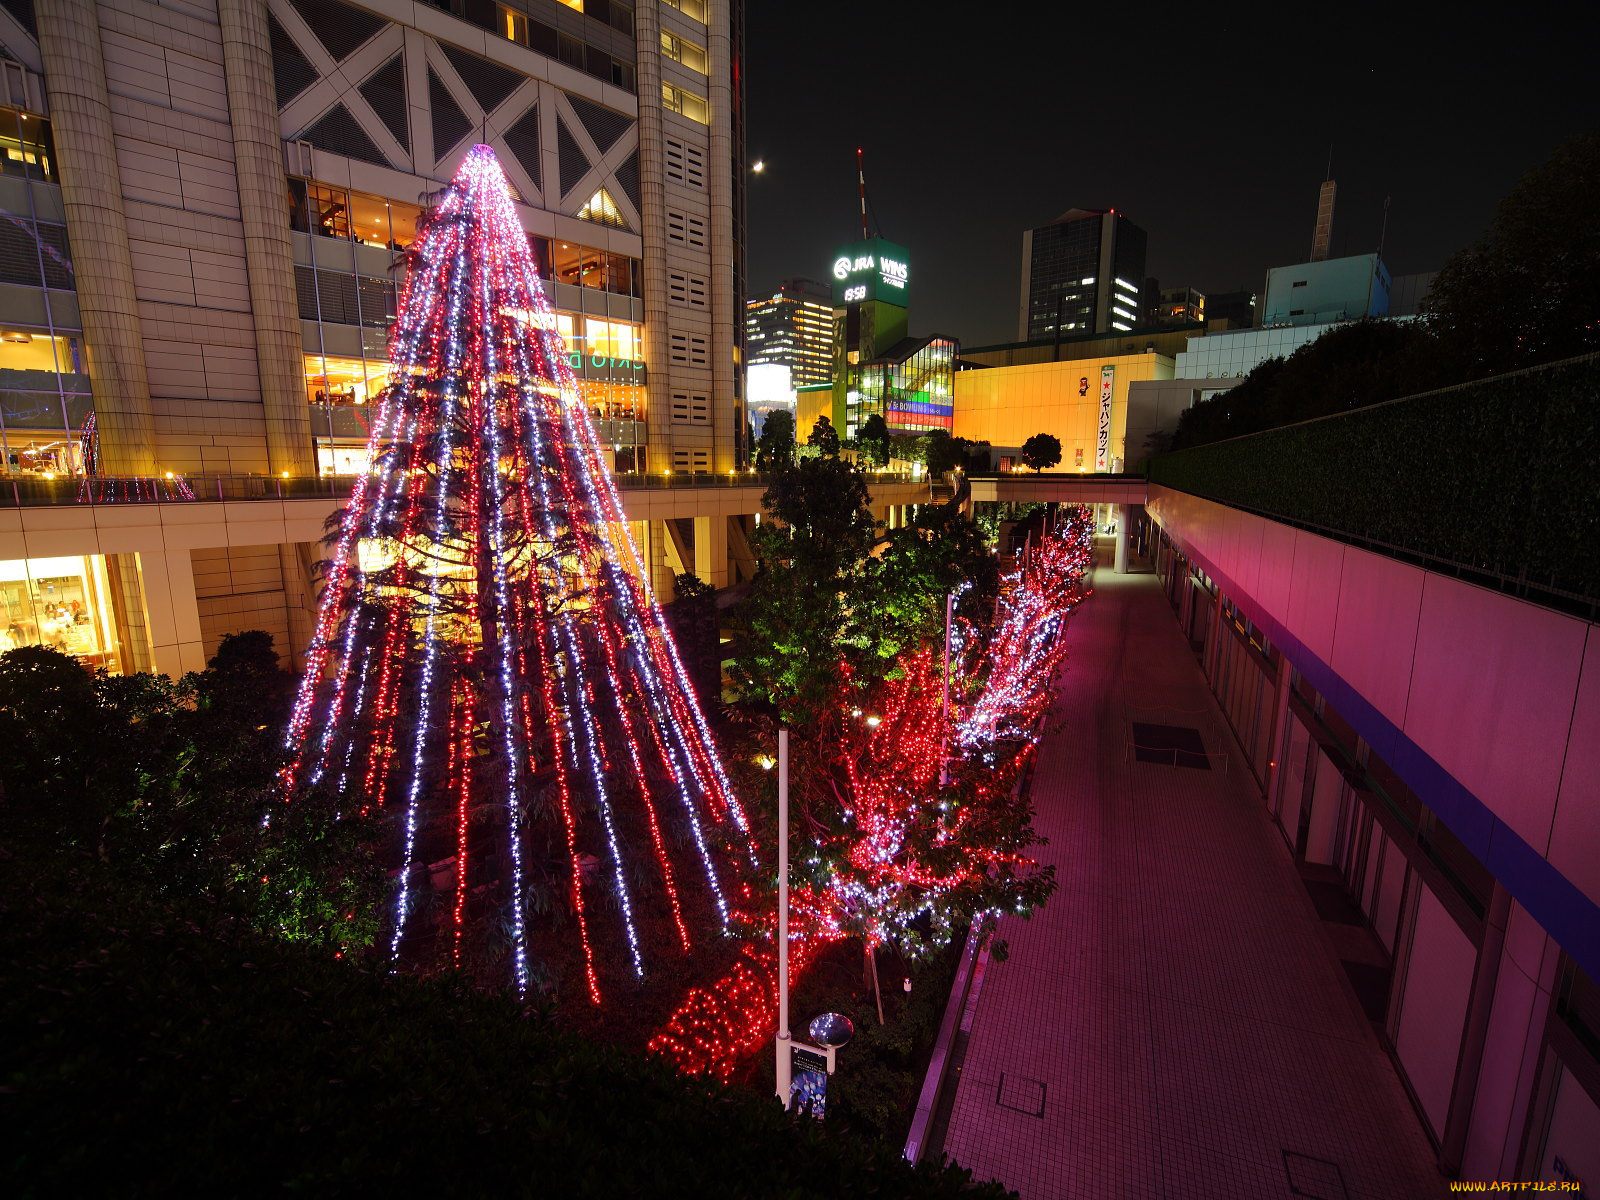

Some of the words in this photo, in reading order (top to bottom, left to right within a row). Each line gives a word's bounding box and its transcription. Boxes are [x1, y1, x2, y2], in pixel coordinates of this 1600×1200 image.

[852, 255, 875, 272] JRA
[880, 256, 908, 279] WINS
[844, 285, 867, 302] 19:58
[899, 402, 927, 414] BOWLING
[1097, 392, 1111, 457] ジャパンカップ
